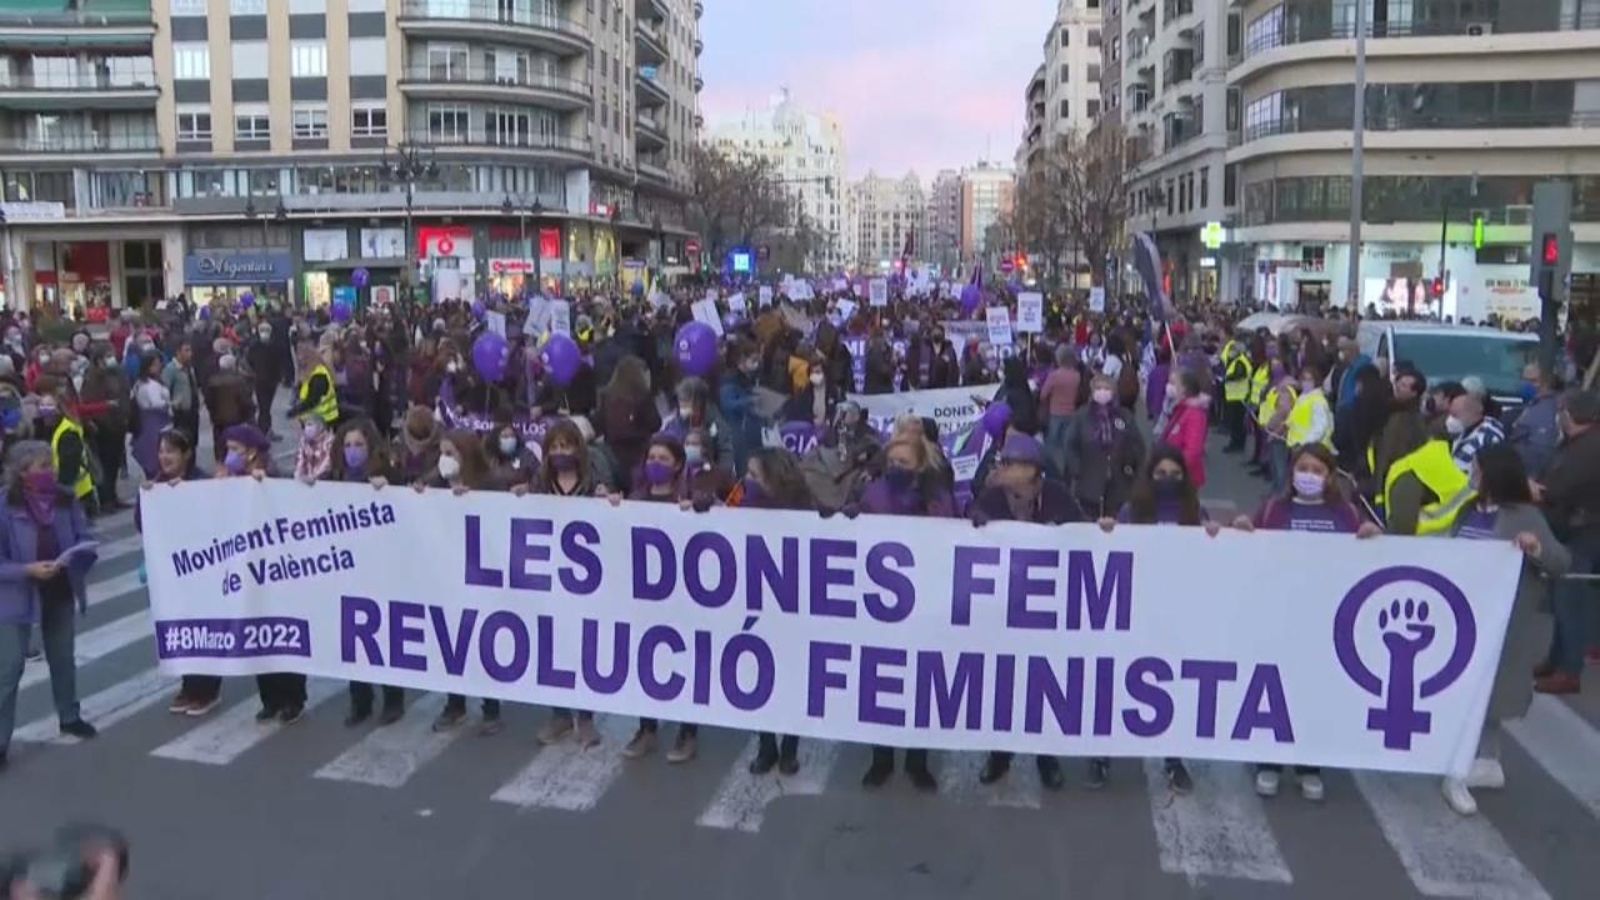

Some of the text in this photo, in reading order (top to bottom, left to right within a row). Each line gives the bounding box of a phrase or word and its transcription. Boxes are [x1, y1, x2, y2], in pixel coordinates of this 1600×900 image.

[934, 405, 975, 418] DONES
[172, 501, 395, 577] Moviment Feminista
[222, 545, 355, 595] de València
[464, 514, 1133, 631] LES DONES FEM
[165, 624, 302, 650] #8Marzo 2022
[340, 596, 1295, 744] REVOLUCIÓ FEMINISTA
